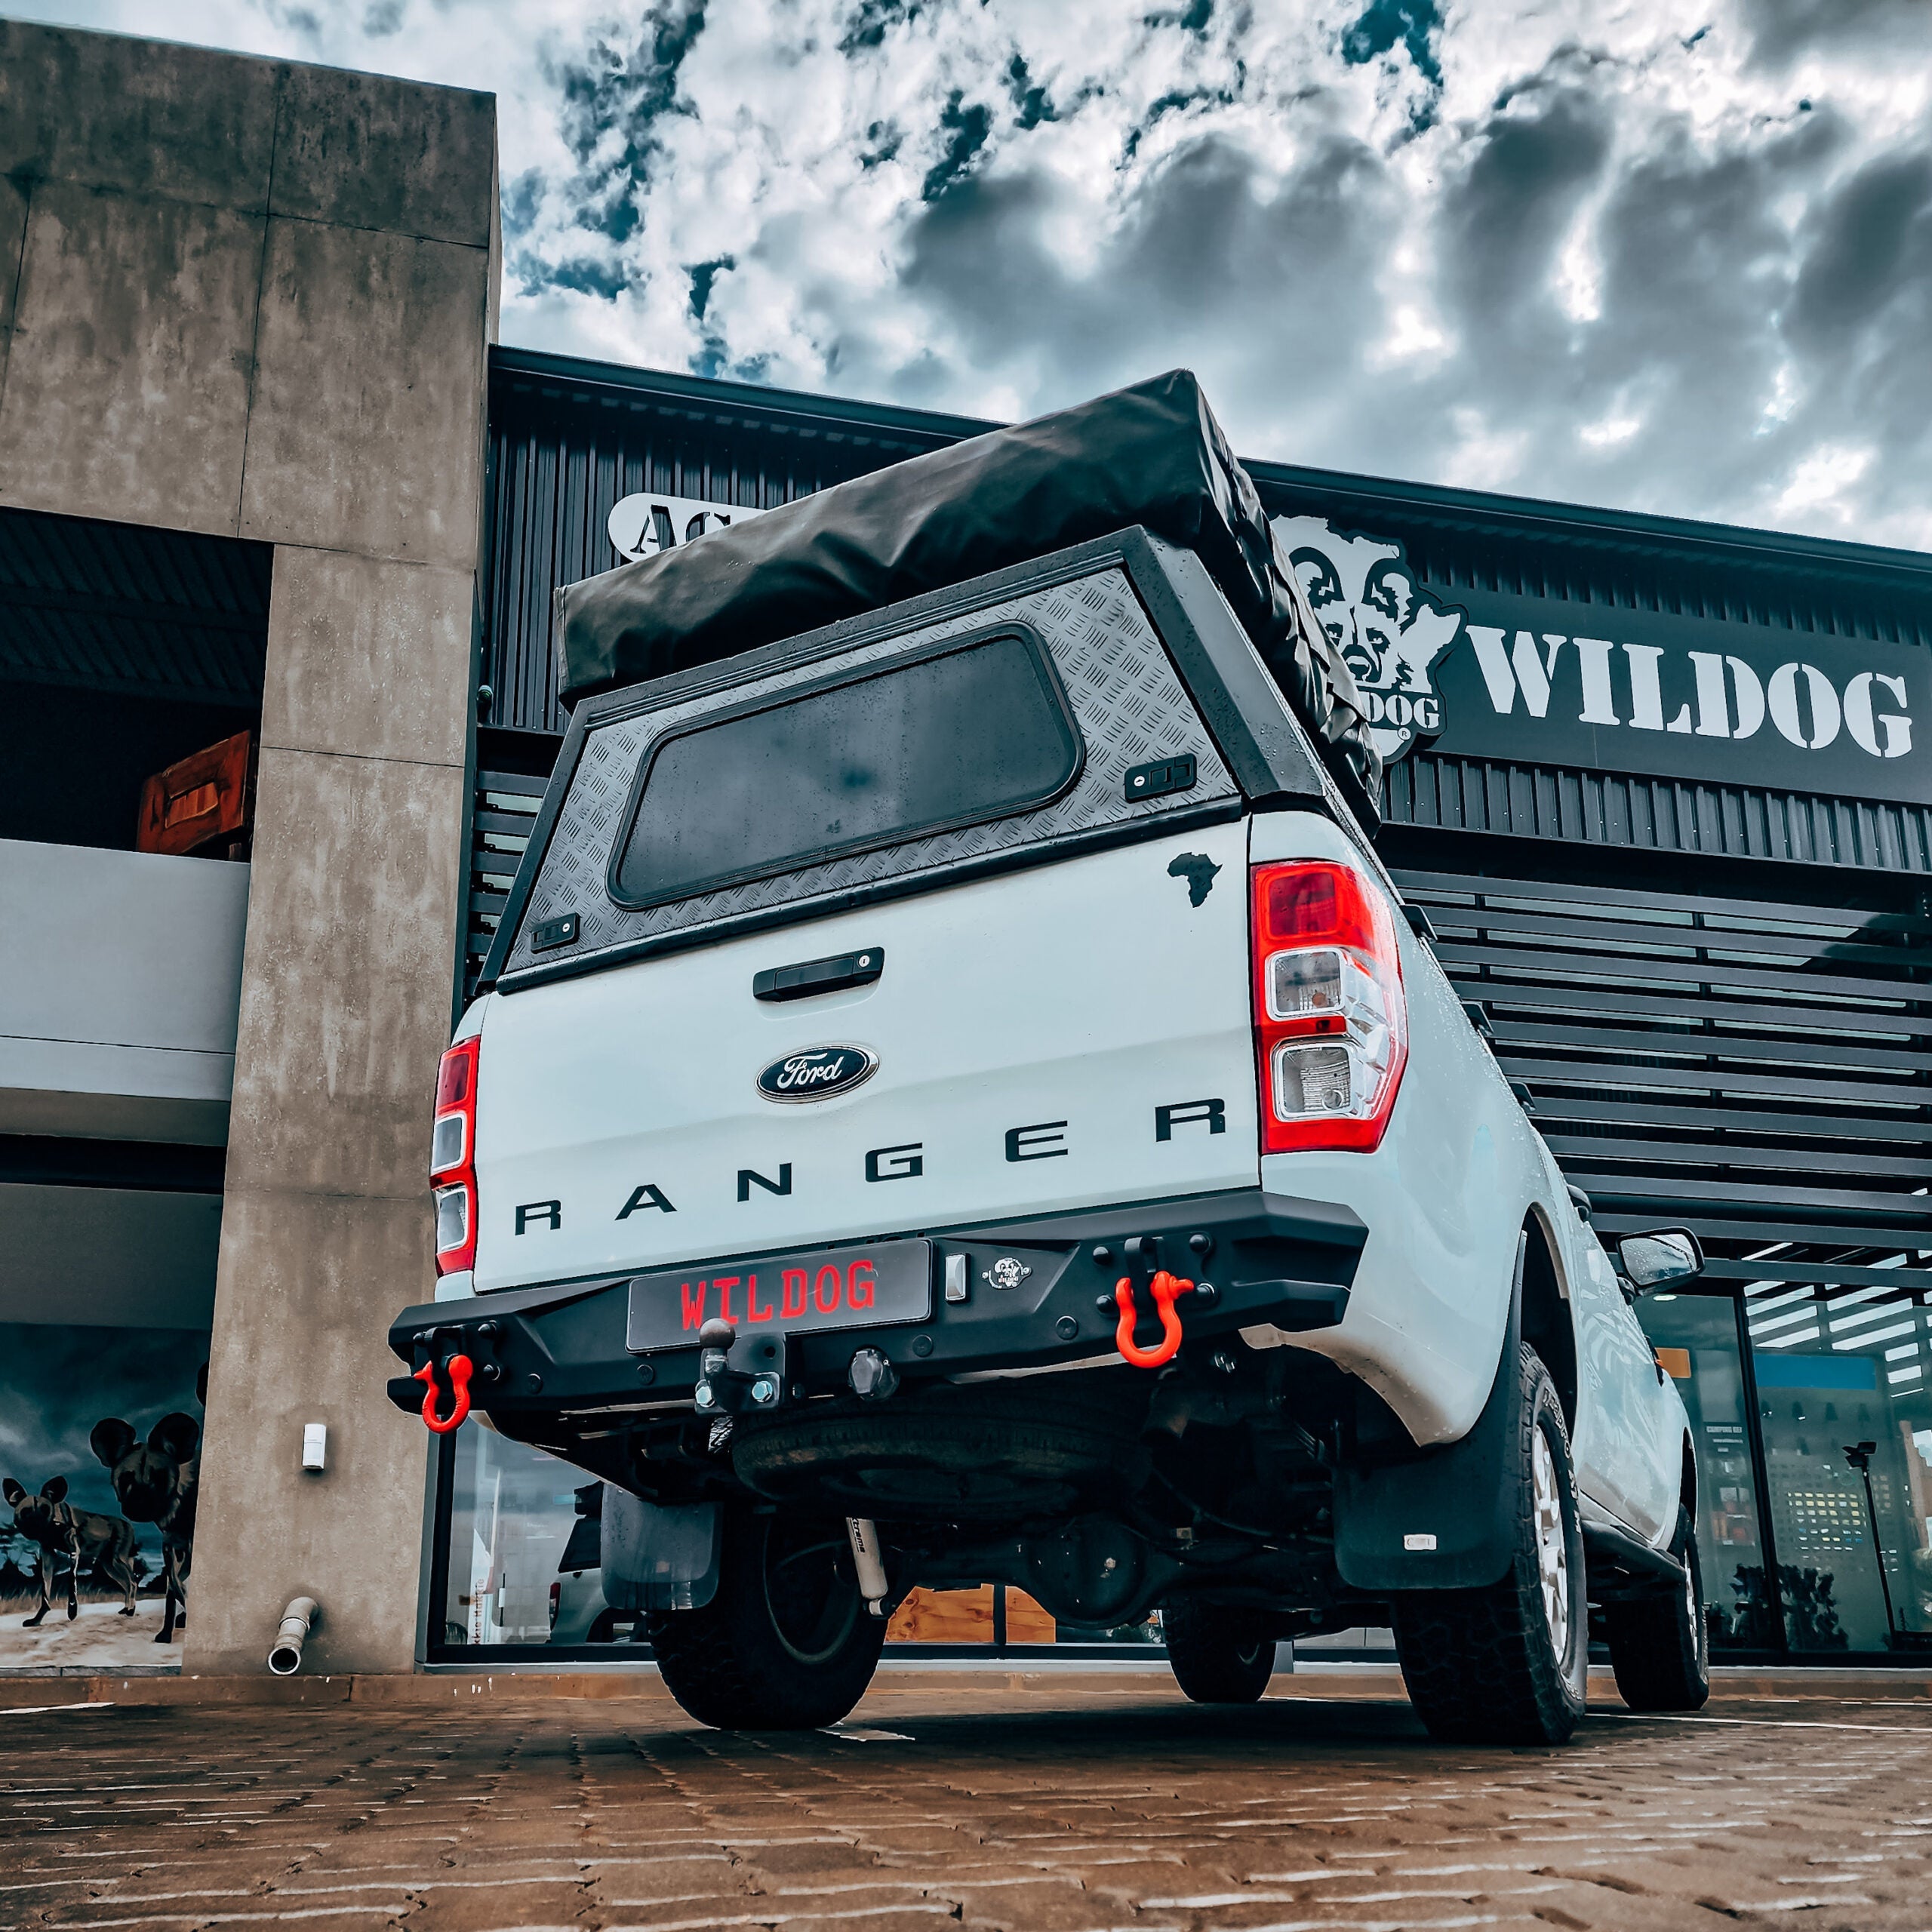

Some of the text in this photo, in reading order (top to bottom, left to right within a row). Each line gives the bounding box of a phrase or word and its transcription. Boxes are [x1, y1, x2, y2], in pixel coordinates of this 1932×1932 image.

[1359, 691, 1439, 728] DOG
[1465, 625, 1912, 758] WILDOG
[777, 1052, 844, 1088] Ford
[515, 1097, 1226, 1235] RANGER
[681, 1260, 875, 1330] WILDOG
